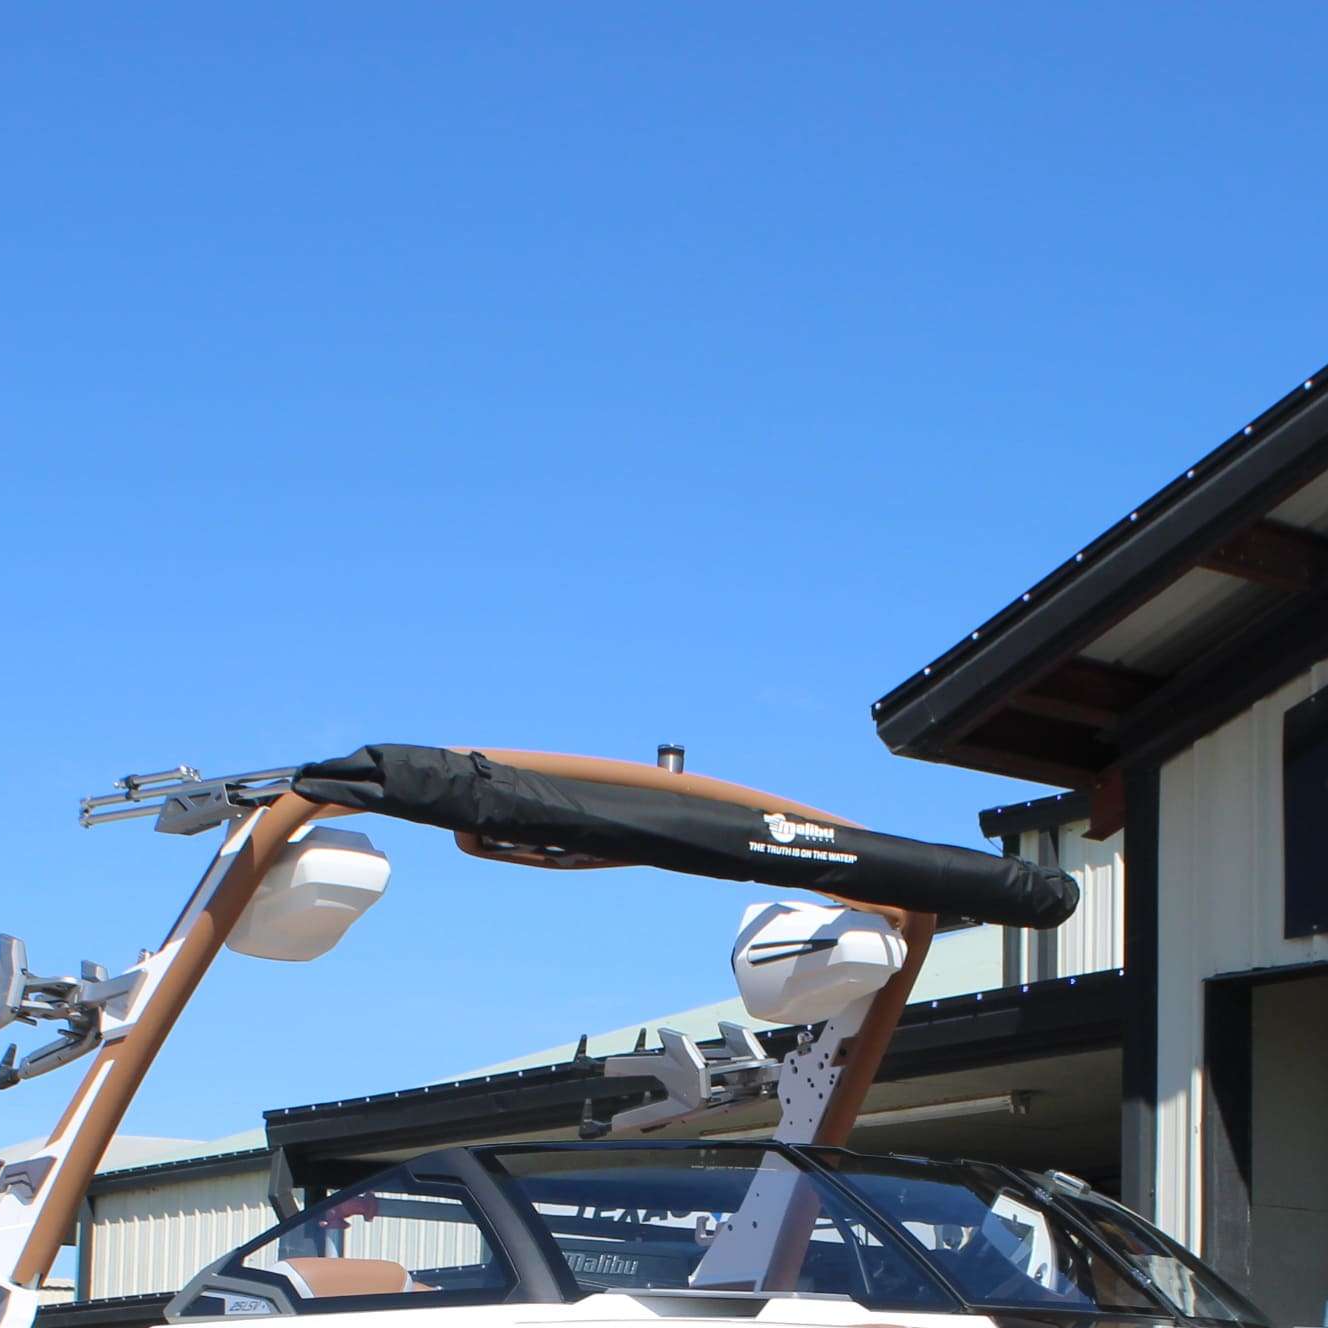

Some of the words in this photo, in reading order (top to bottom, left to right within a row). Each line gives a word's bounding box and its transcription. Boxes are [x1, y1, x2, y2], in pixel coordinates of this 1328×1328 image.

[749, 841, 766, 853] THE
[767, 844, 791, 857] TRUTH
[792, 847, 800, 858] IS
[801, 848, 812, 859] ON
[813, 850, 827, 861] THE
[566, 1253, 639, 1275] Malibu
